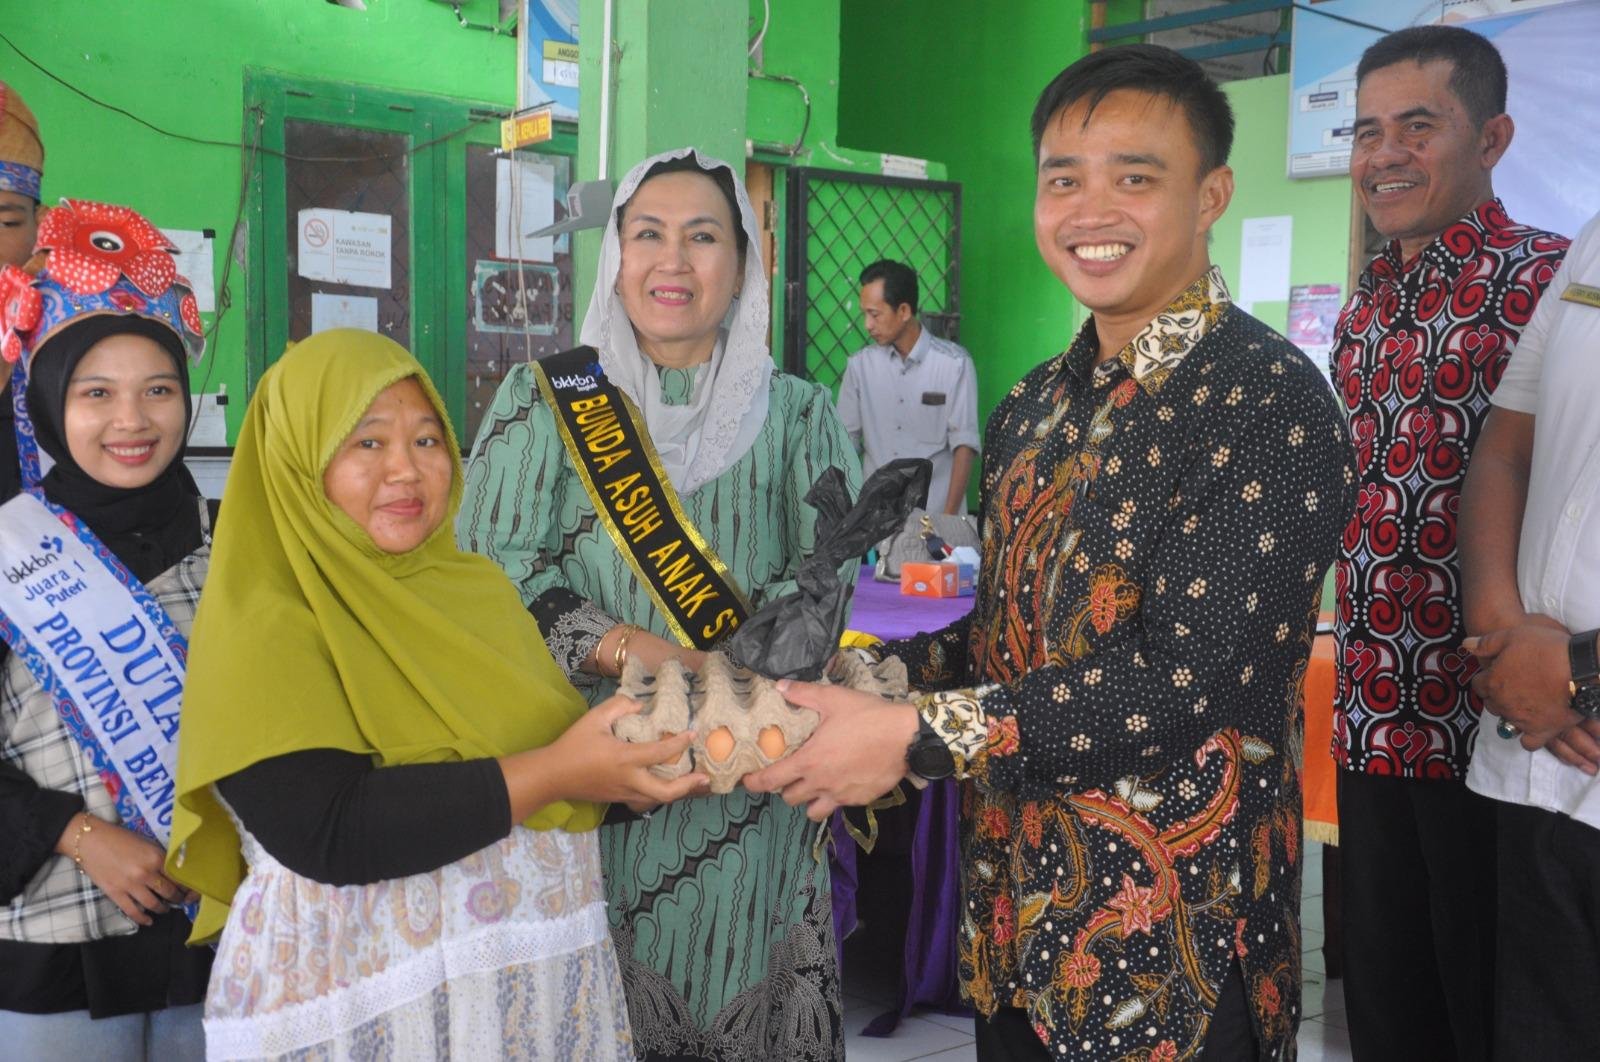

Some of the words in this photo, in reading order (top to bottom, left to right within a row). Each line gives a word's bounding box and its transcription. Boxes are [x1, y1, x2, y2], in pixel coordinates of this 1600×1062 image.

[336, 238, 371, 248] KAWASAN
[336, 247, 359, 257] TANPA
[552, 374, 596, 390] bkkbn
[571, 393, 632, 473] BUNDA
[604, 471, 664, 545] ASUH
[647, 539, 720, 619] ANAK
[702, 606, 739, 640] S
[5, 550, 59, 585] bkkbn
[24, 568, 71, 602] Juara
[45, 579, 88, 609] Puteri
[33, 610, 141, 745] PROVINSI
[124, 744, 177, 835] BENG
